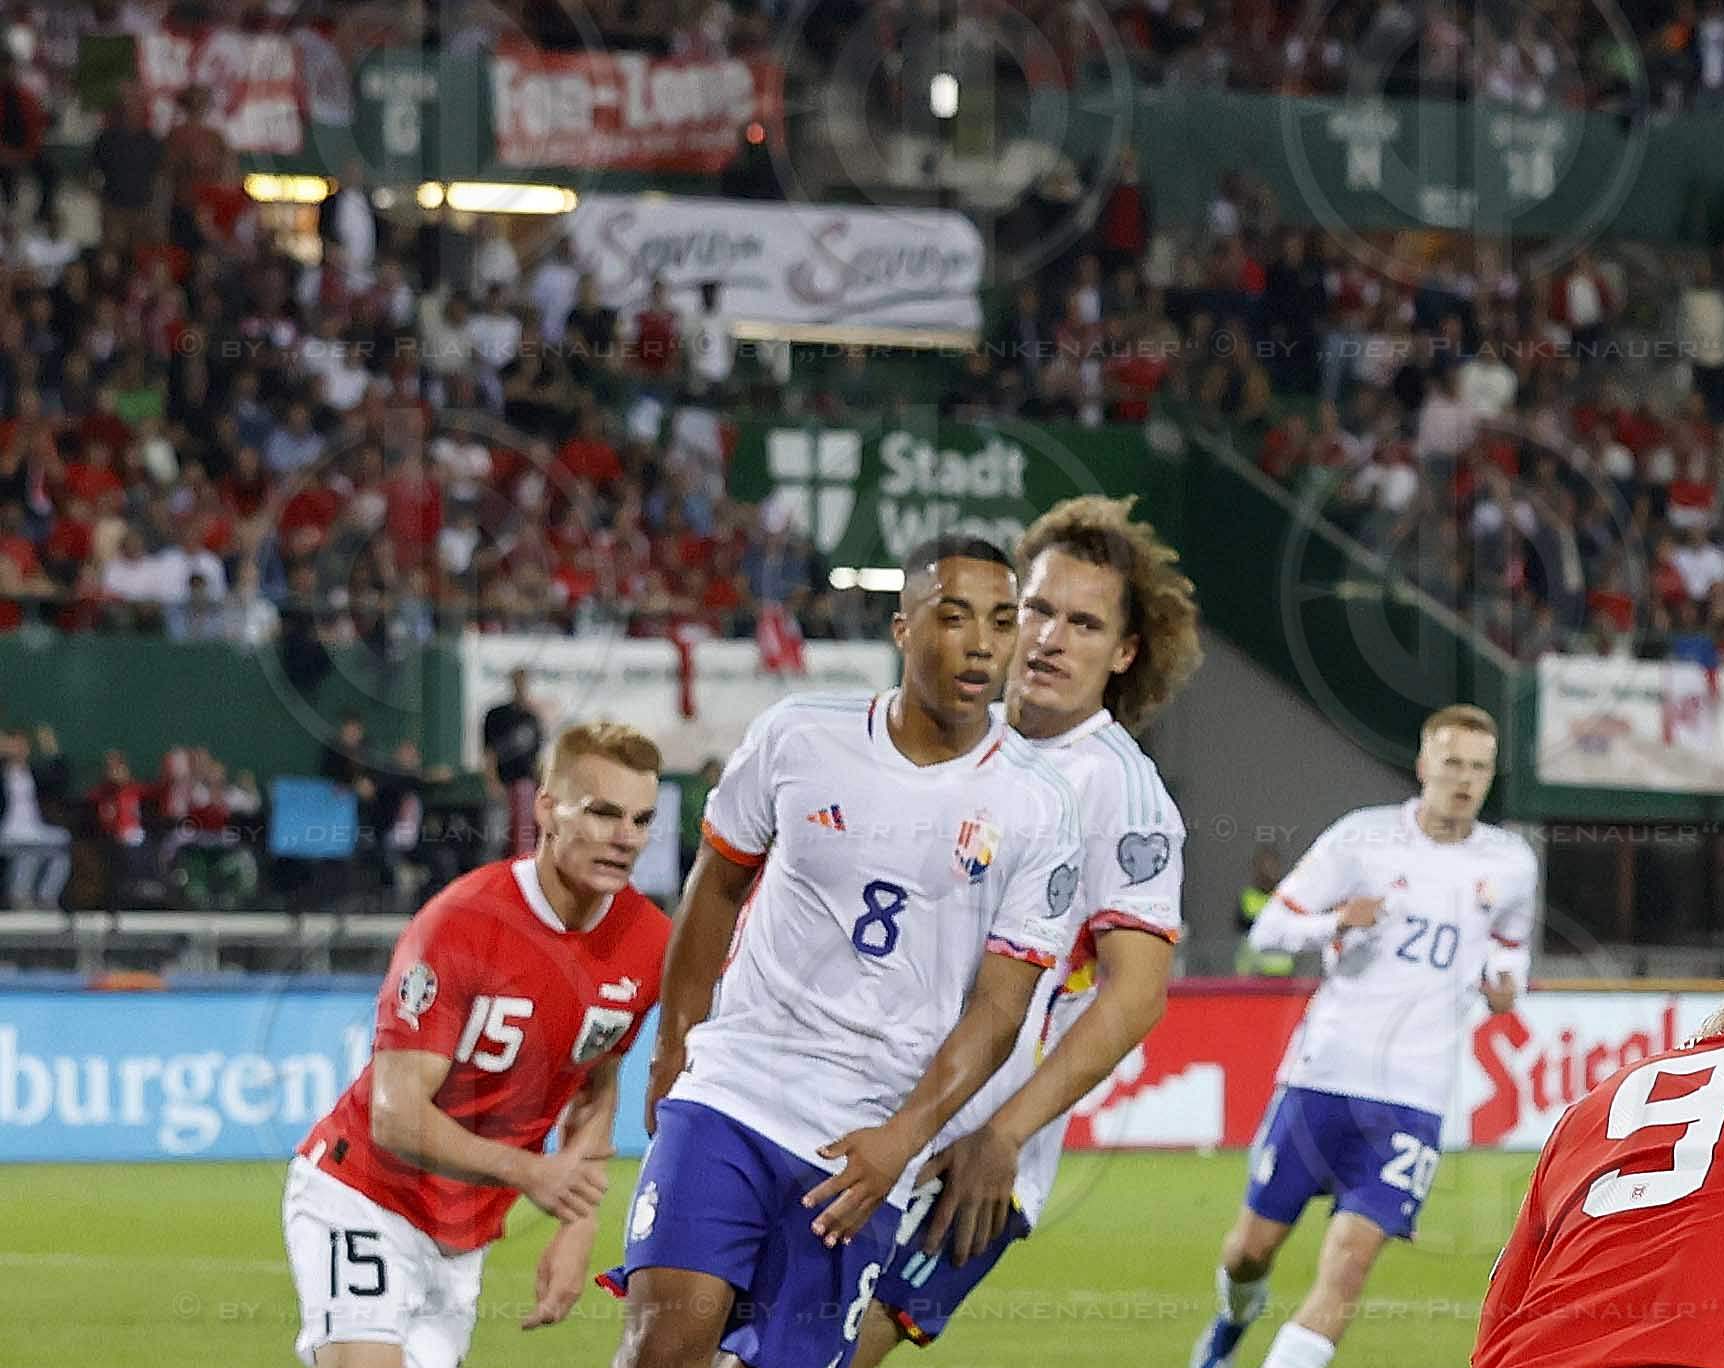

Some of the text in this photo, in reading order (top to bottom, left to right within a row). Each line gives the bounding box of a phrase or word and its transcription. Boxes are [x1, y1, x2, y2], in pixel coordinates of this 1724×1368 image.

[878, 431, 1027, 497] Stadt
[852, 879, 908, 957] 8
[1396, 915, 1459, 970] 20
[455, 994, 534, 1072] 15
[1380, 1131, 1441, 1202] 20
[329, 1229, 387, 1298] 15
